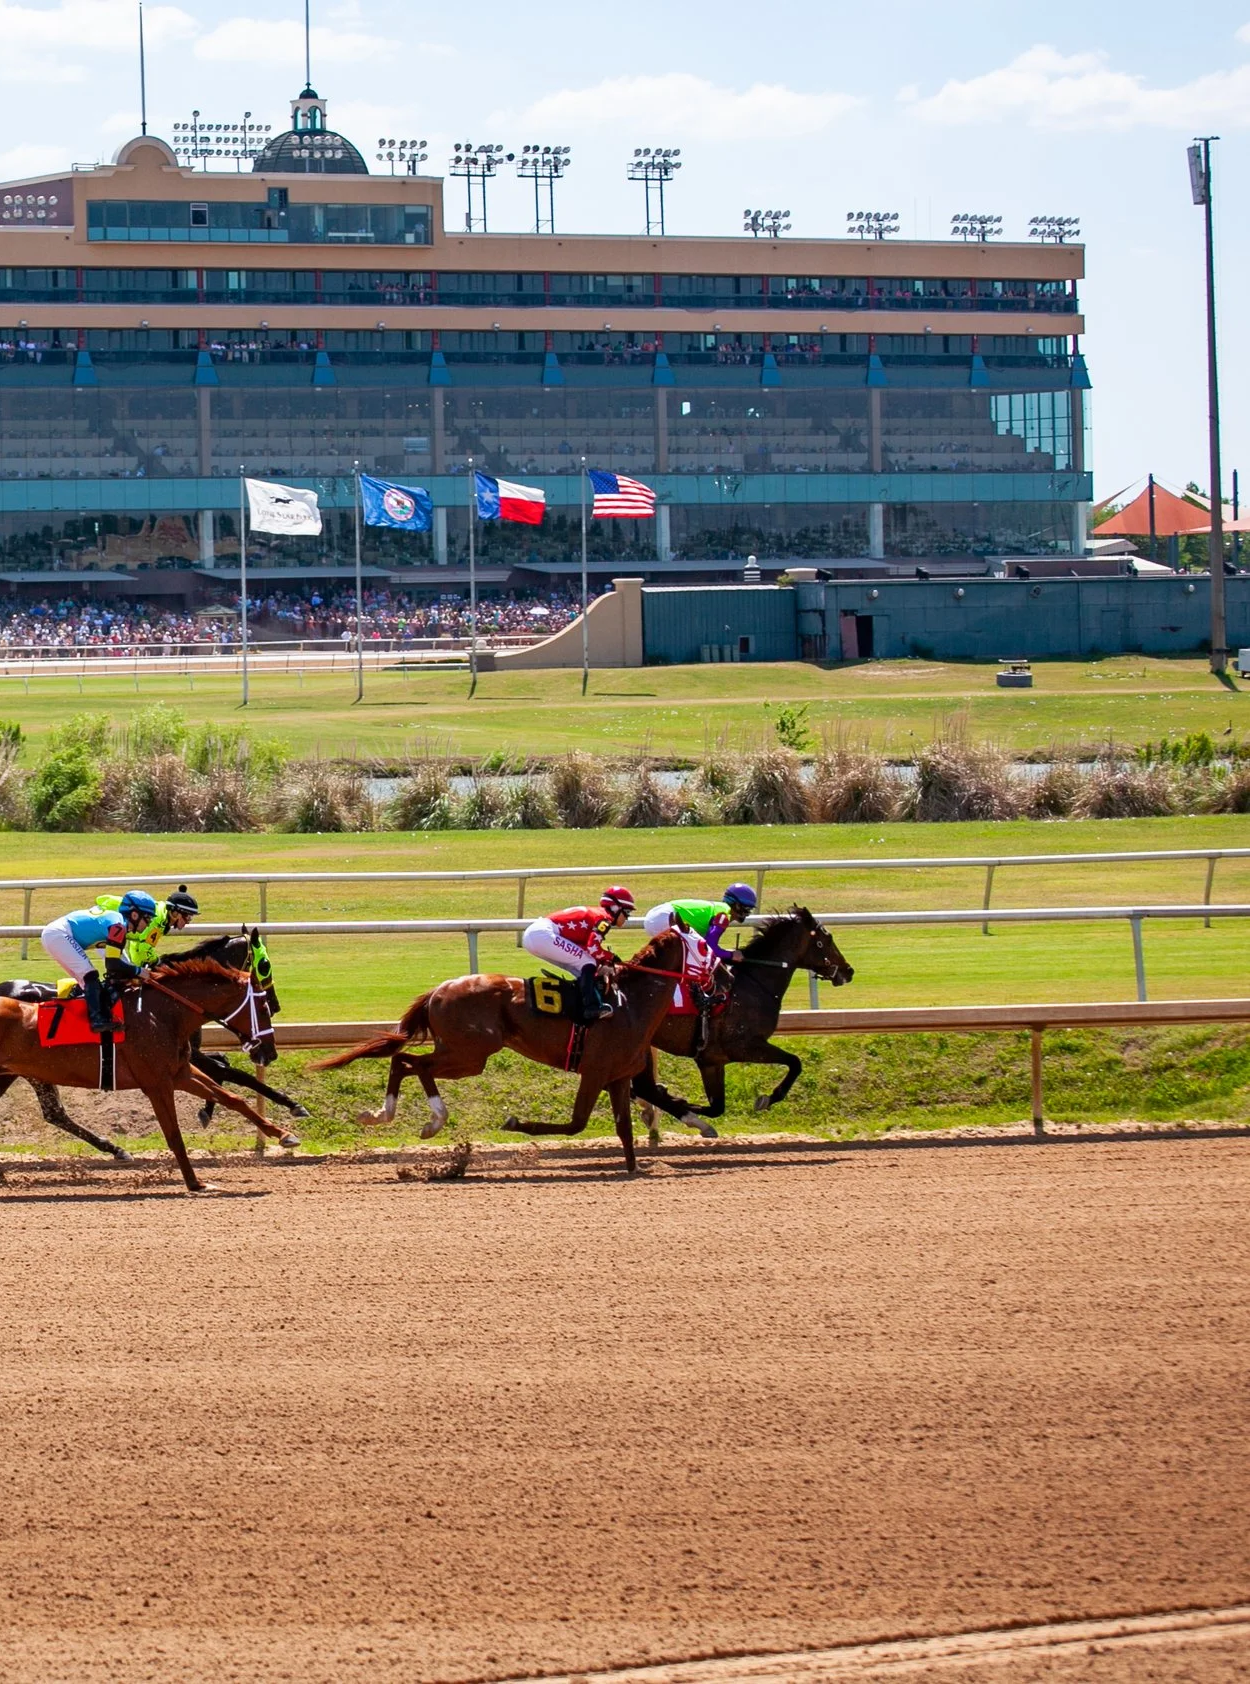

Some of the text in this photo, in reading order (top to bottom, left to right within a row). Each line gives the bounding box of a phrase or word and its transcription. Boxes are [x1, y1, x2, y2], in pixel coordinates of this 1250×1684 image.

[112, 925, 123, 938] 7
[597, 921, 609, 932] 6
[64, 934, 88, 960] ROSIER
[553, 936, 584, 960] SASHA
[532, 976, 562, 1014] 6
[40, 1003, 65, 1040] 7
